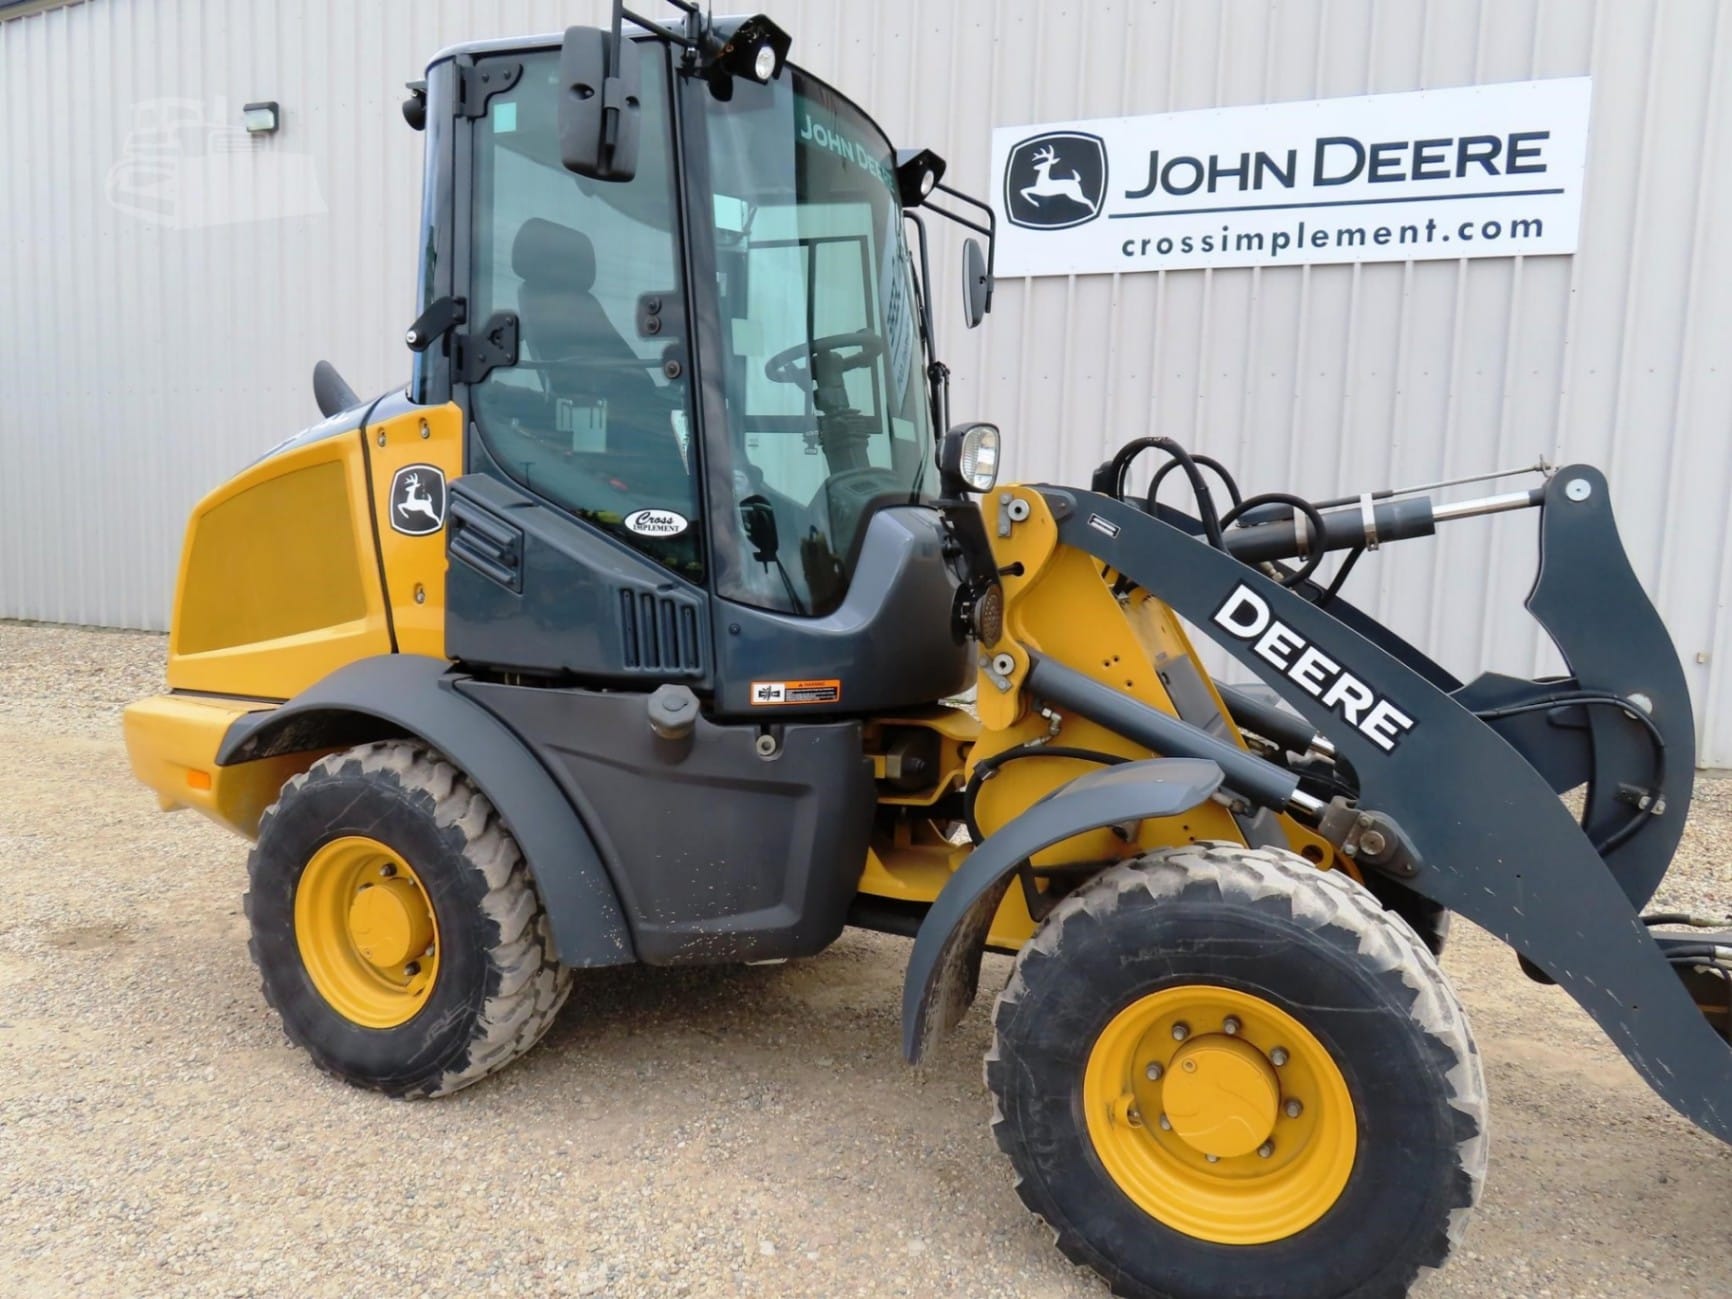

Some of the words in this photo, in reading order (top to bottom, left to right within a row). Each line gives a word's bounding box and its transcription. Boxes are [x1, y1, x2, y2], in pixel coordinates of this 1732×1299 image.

[800, 114, 855, 163] JOHN
[1124, 149, 1298, 200] JOHN
[1312, 130, 1550, 187] DEERE
[1122, 218, 1543, 257] crossimplement.com
[632, 524, 679, 533] IMPLEMENT
[636, 512, 673, 525] Cross
[1213, 583, 1414, 751] DEERE
